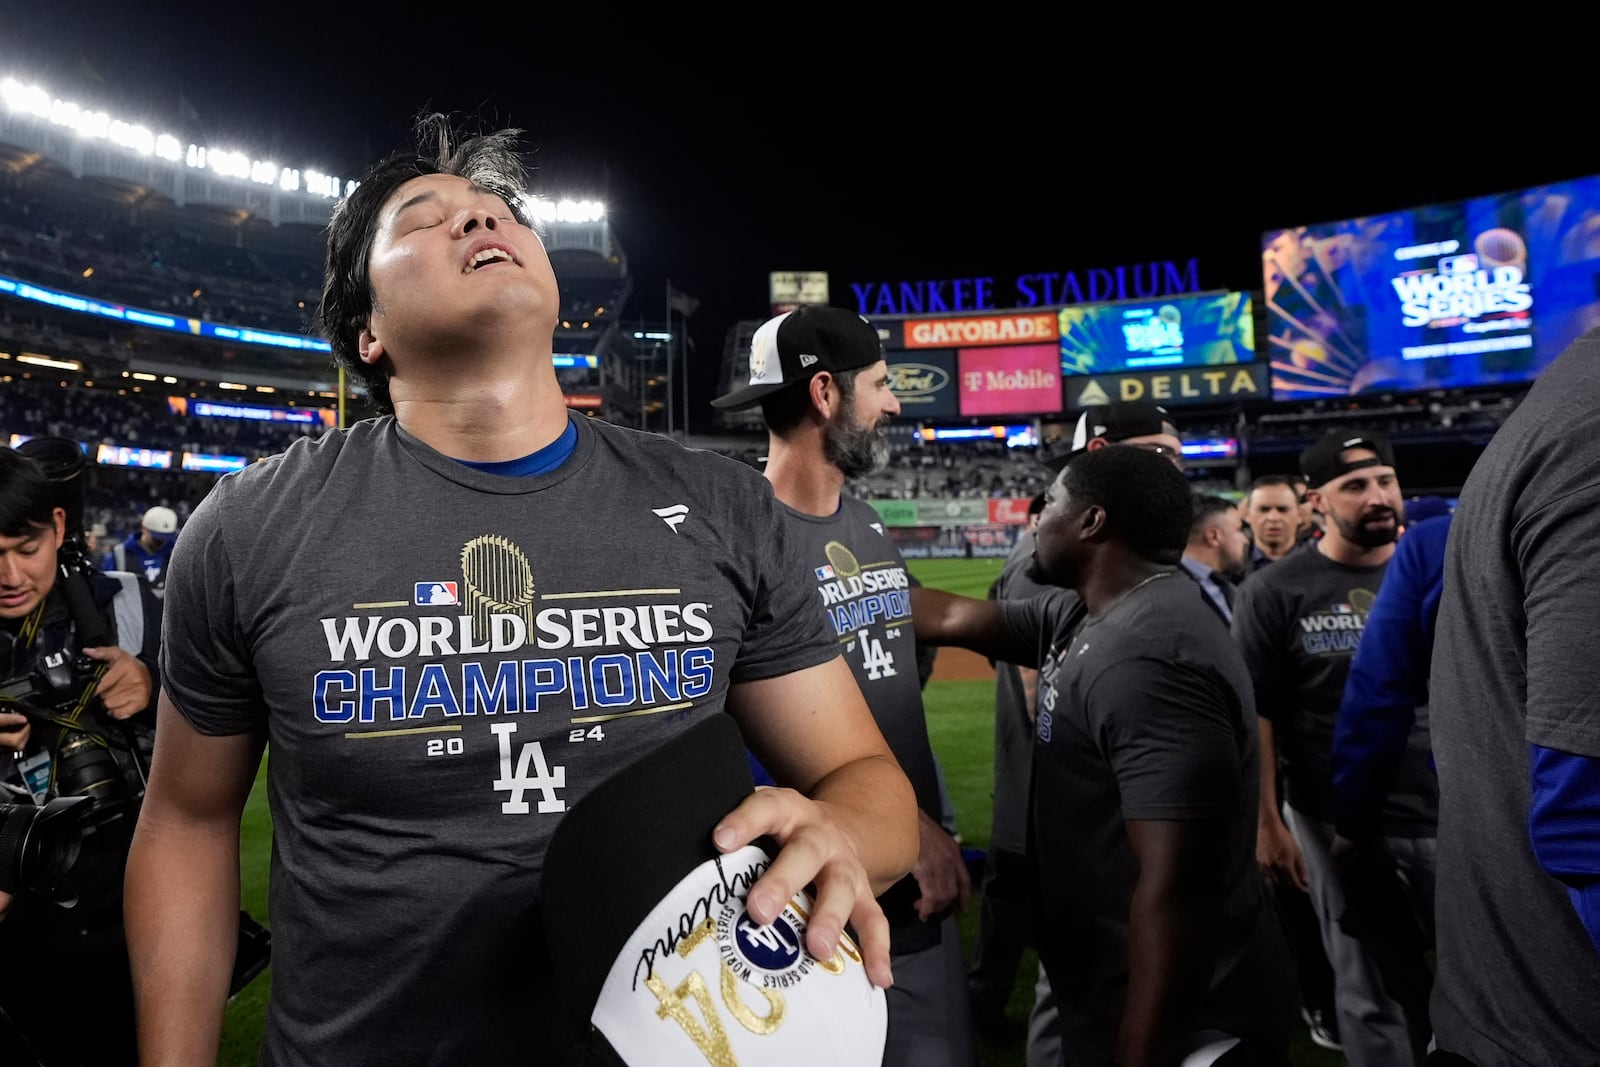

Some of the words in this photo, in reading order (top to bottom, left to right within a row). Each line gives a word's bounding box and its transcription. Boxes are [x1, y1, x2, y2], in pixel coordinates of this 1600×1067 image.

[850, 277, 994, 314] YANKEE
[1016, 257, 1201, 309] STADIUM
[1391, 267, 1523, 302] WORLD
[1401, 285, 1533, 327] SERIES
[912, 315, 1052, 343] GATORADE
[986, 369, 1056, 391] Mobile
[1120, 370, 1257, 401] DELTA
[818, 576, 863, 606] ORLD
[320, 613, 526, 661] WORLD
[536, 603, 714, 649] SERIES
[1300, 614, 1368, 632] WORL
[858, 629, 898, 680] LA
[313, 647, 714, 723] CHAMPIONS
[427, 738, 464, 757] 20
[569, 725, 605, 743] 24
[490, 722, 566, 815] LA
[716, 904, 736, 941] SERIES
[719, 944, 751, 982] WORLD
[762, 970, 801, 989] SERIES
